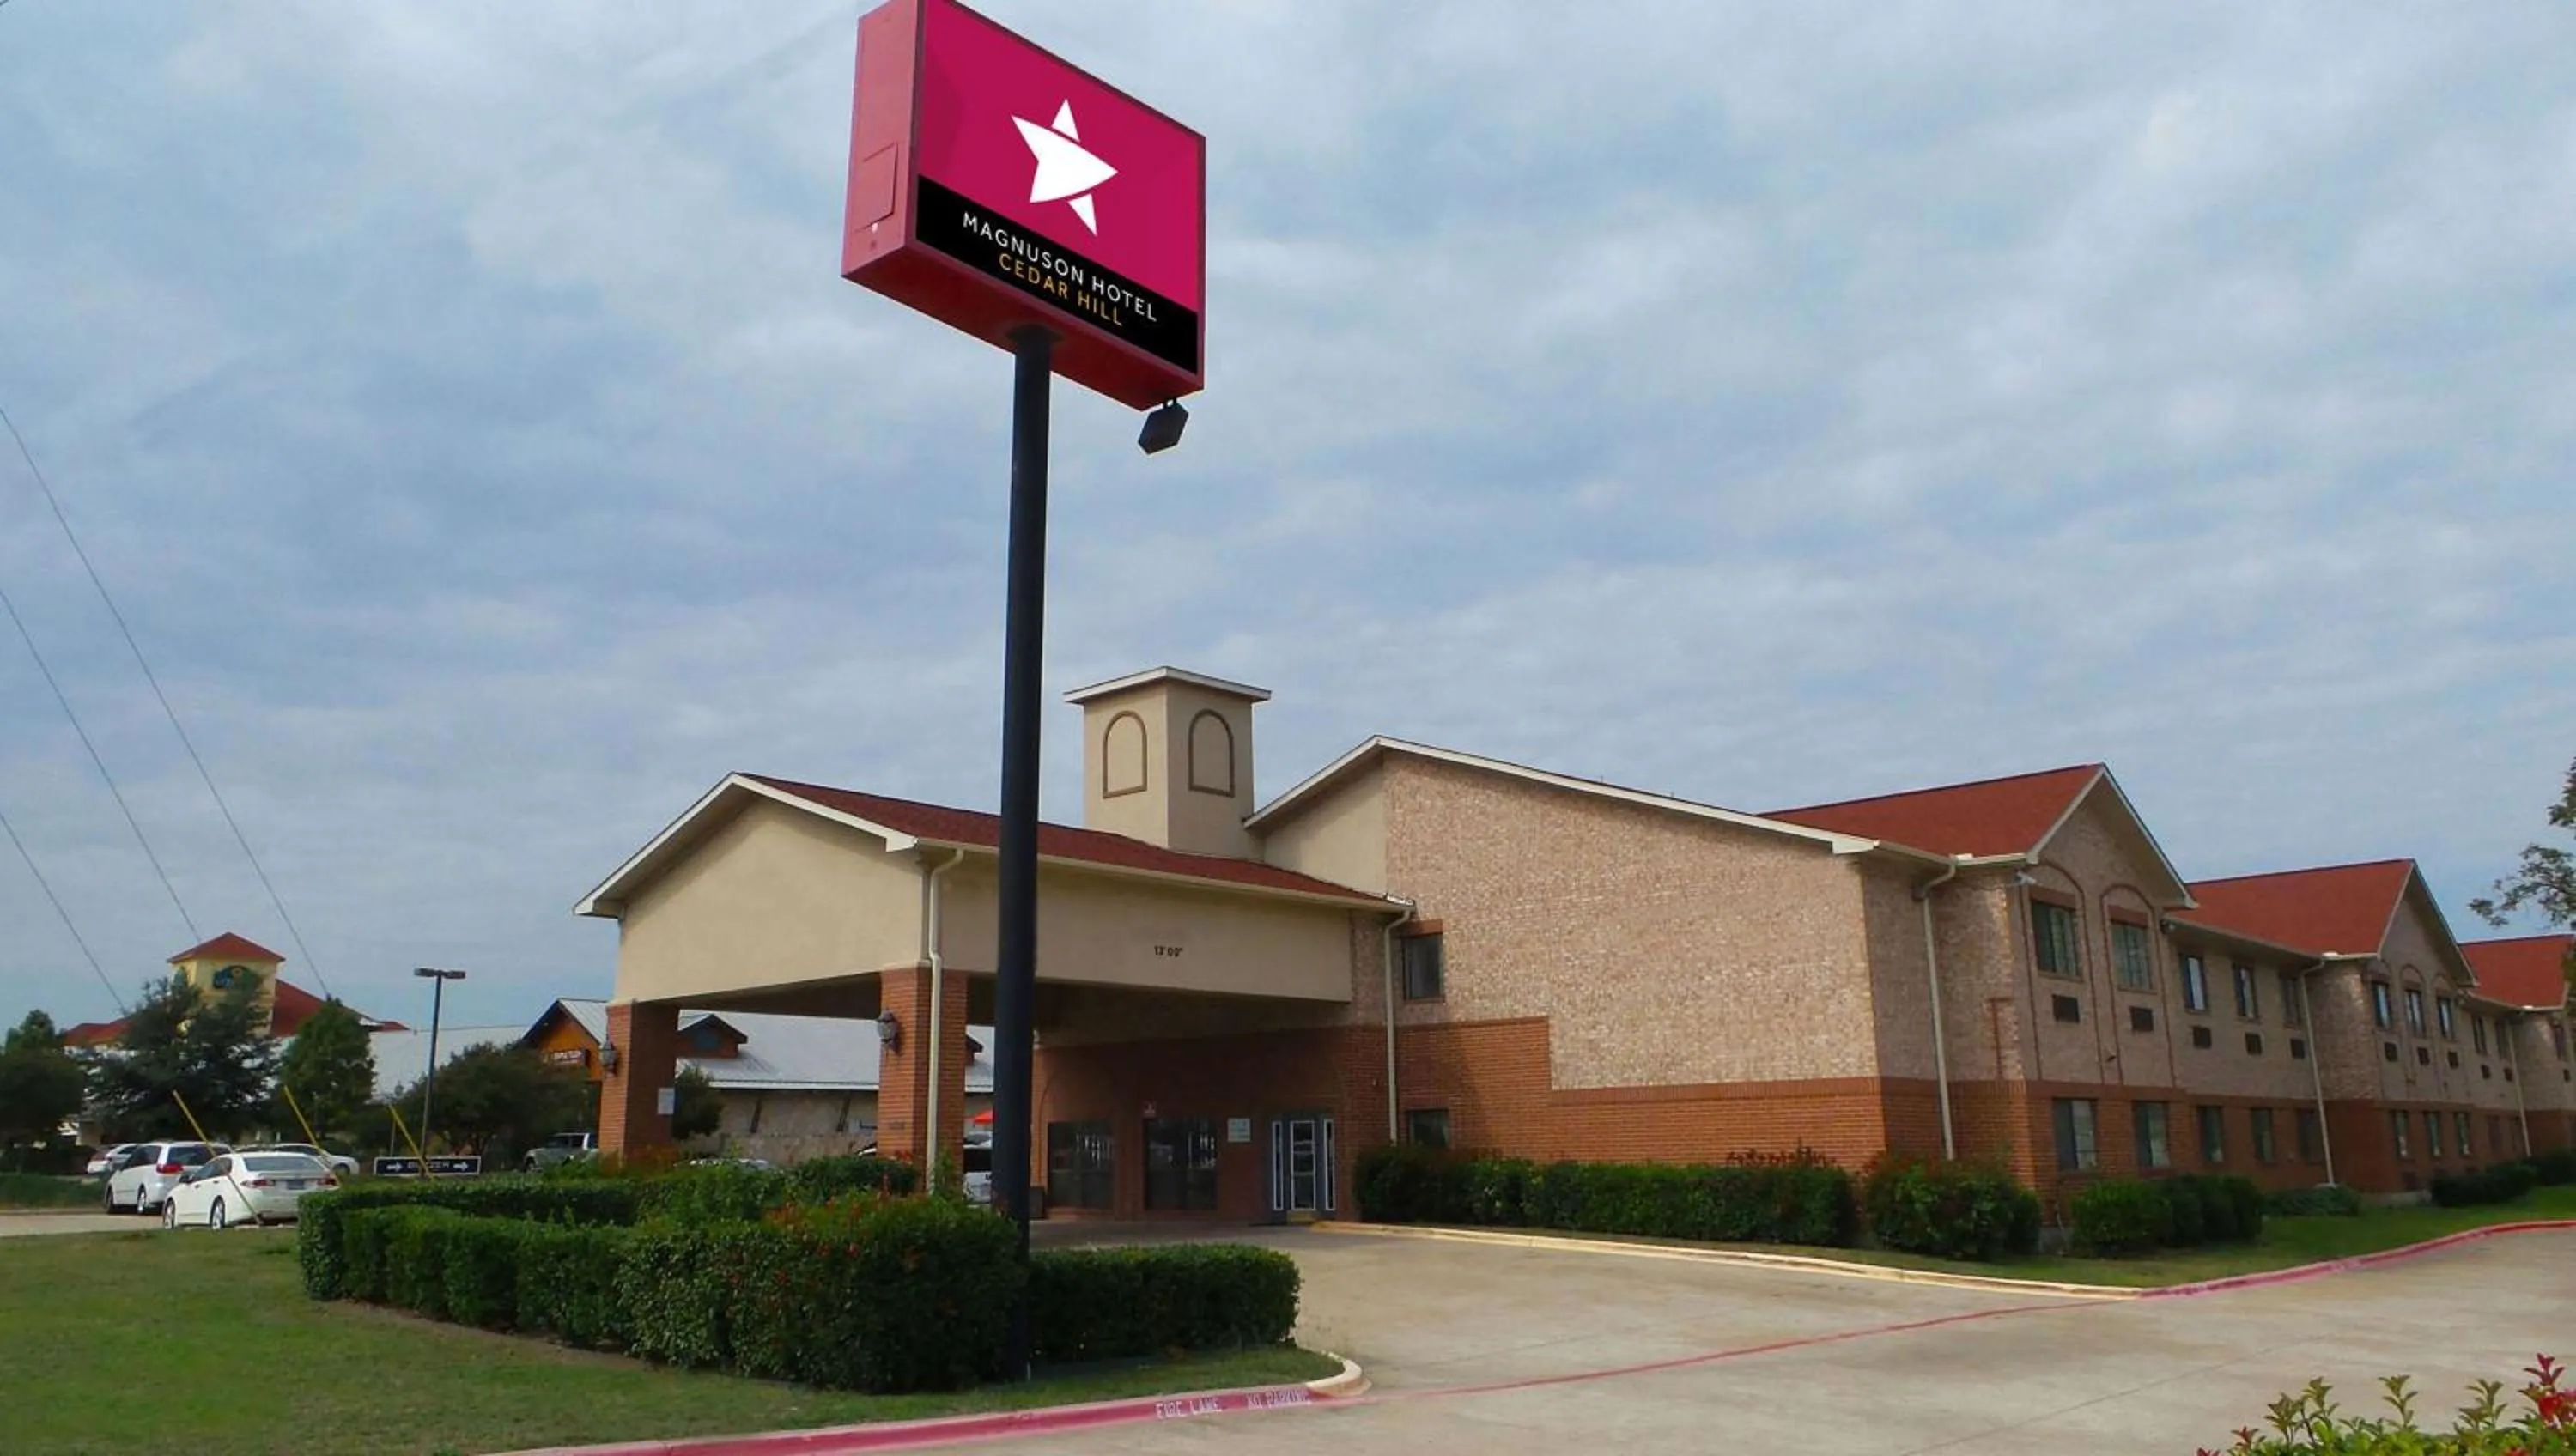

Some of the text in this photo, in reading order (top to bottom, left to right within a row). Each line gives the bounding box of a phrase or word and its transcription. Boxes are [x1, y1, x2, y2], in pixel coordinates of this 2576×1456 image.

[963, 212, 1157, 322] MAGNUSON HOTEL
[999, 253, 1122, 326] CEDAR HILL
[1155, 1400, 1187, 1419] FIRE
